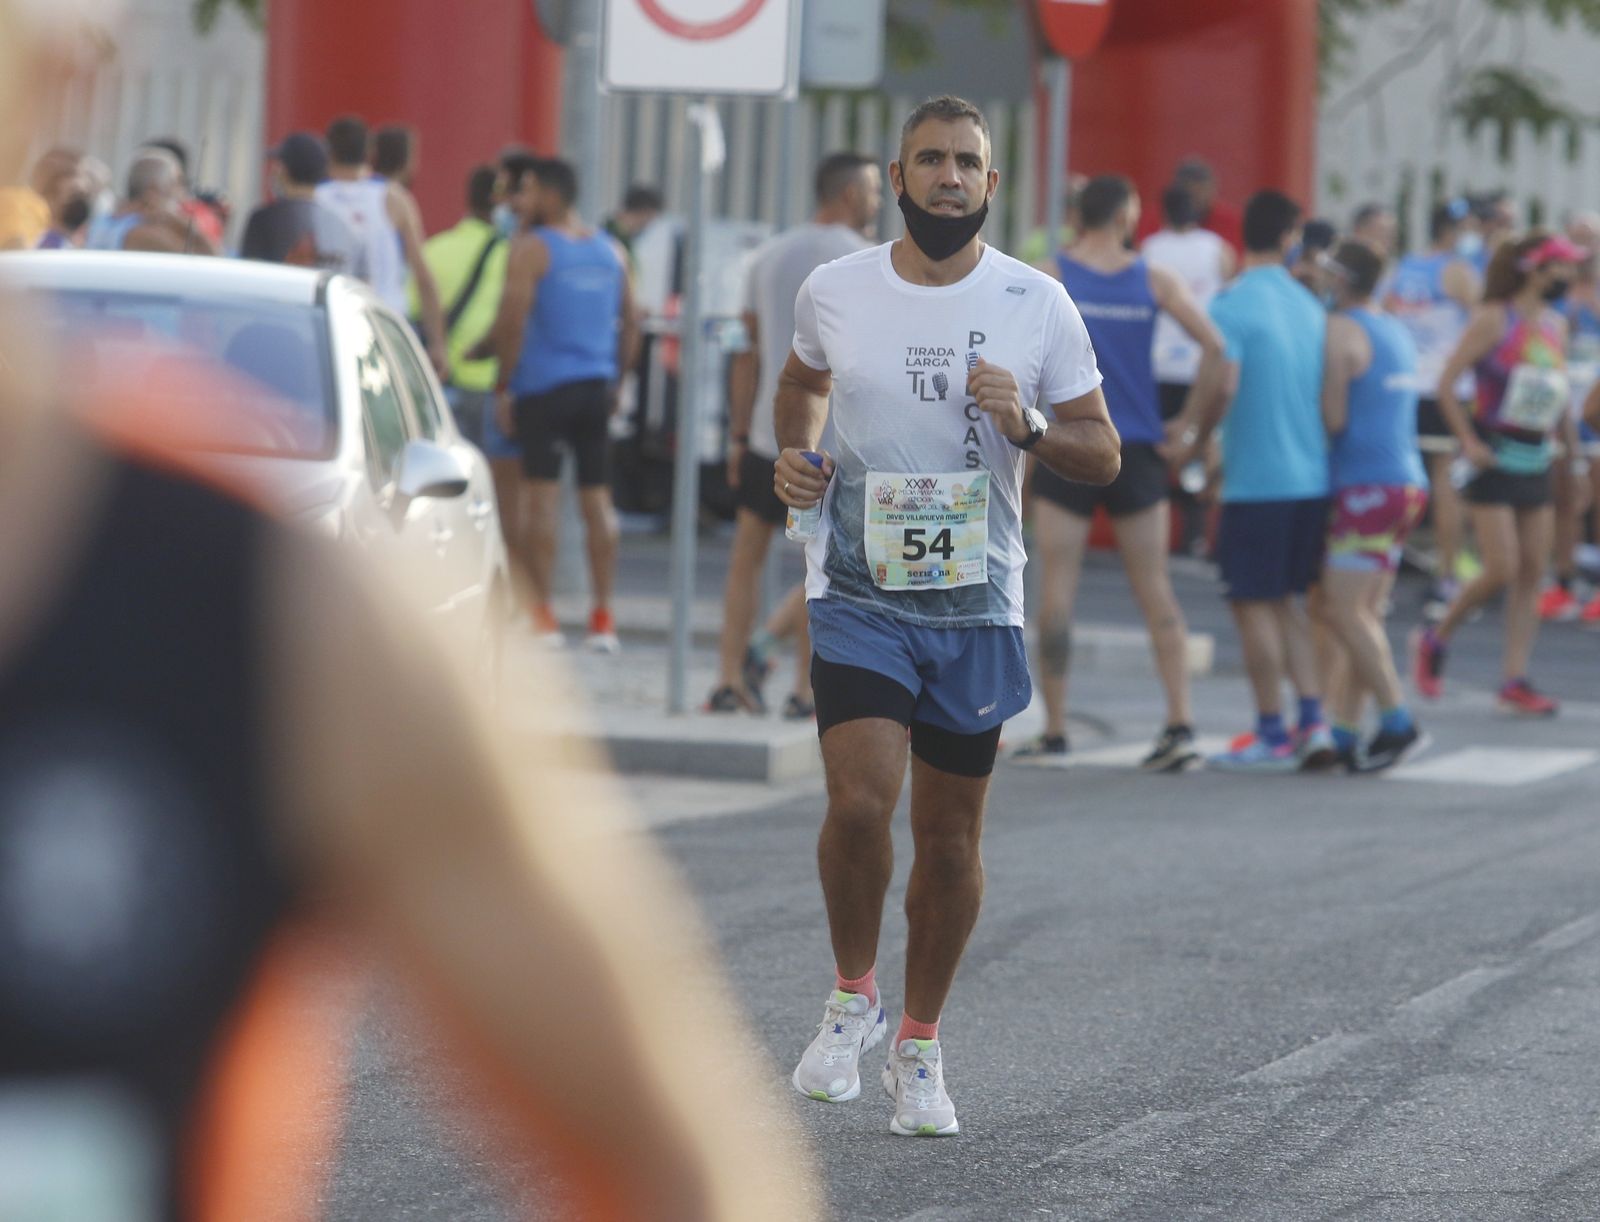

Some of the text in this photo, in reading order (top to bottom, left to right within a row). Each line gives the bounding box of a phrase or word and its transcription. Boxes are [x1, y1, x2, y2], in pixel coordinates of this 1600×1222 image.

[906, 346, 956, 357] TIRADA
[905, 358, 951, 367] LARGA
[904, 478, 938, 489] XXXV
[877, 497, 894, 505] VAR
[905, 513, 945, 521] VILLANUEVA
[902, 528, 955, 561] 54
[907, 568, 951, 578] serizona
